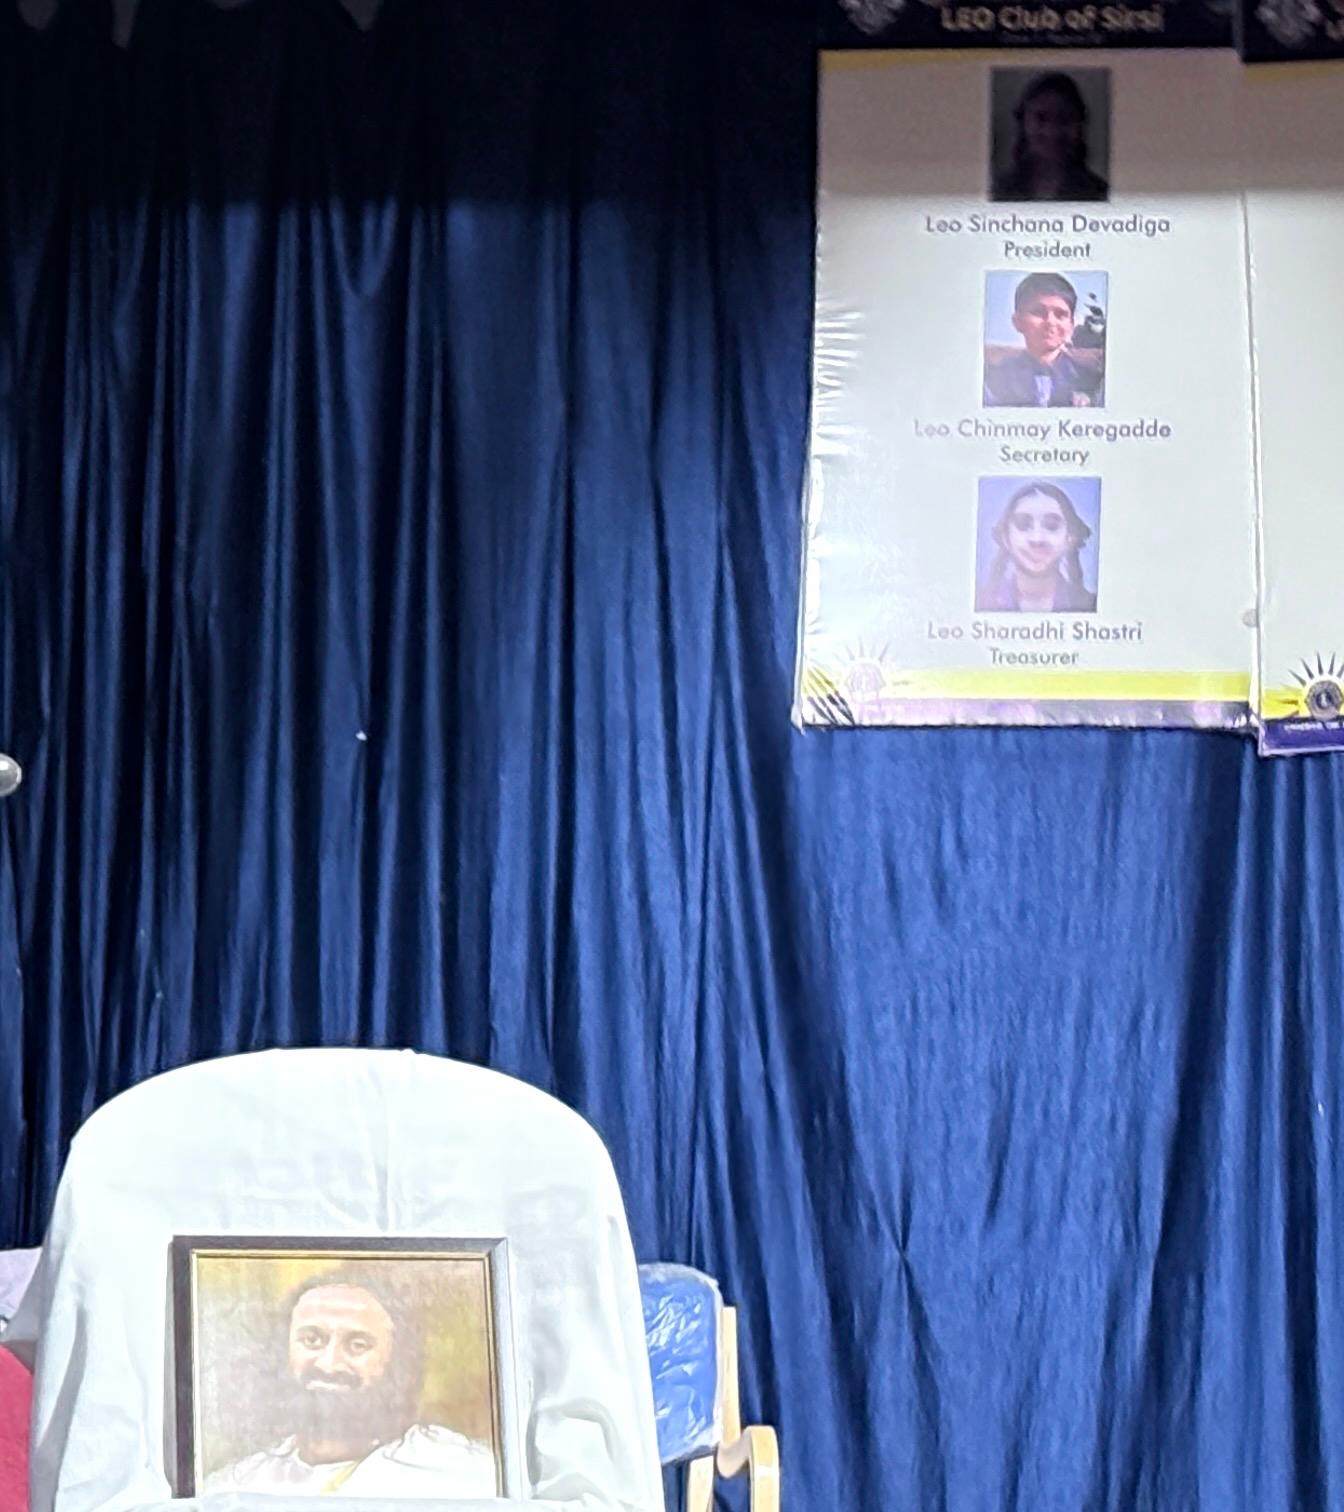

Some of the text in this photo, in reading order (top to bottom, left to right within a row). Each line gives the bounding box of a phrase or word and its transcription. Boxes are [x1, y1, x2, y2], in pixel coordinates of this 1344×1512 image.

[998, 6, 1061, 31] Club
[1065, 6, 1099, 30] of
[925, 213, 1171, 239] Leo Sinchana Devadiga
[1003, 240, 1091, 258] President
[914, 419, 1172, 443] Leo Chinmay Keregadde
[999, 446, 1090, 466] Secretary
[927, 622, 1142, 641] Leo Sharadhi Shastri
[990, 648, 1079, 665] Treasurer
